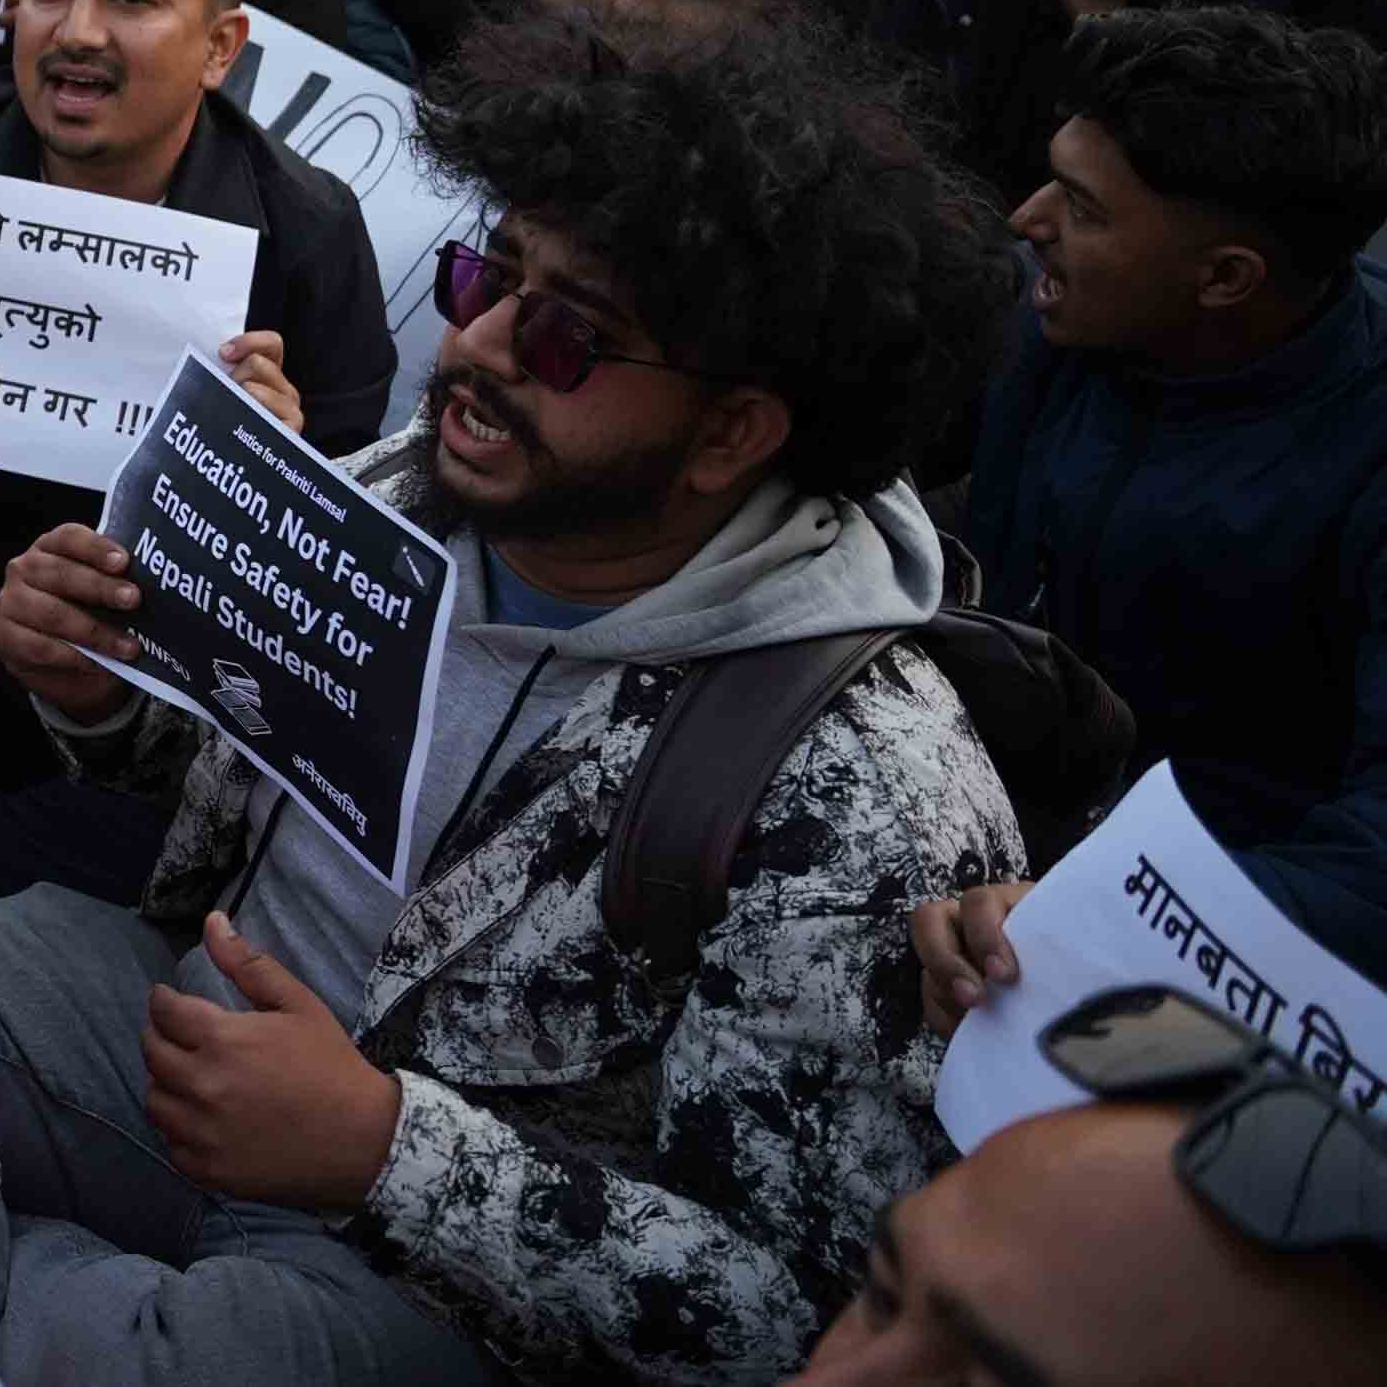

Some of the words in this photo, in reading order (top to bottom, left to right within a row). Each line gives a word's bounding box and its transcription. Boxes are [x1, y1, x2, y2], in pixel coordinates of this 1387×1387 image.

[17, 220, 200, 282] लम्सालको
[43, 387, 98, 429] गर
[163, 411, 273, 535] Education,
[278, 508, 331, 574] Not
[332, 548, 413, 630] Fear!
[232, 423, 264, 458] Justice
[262, 444, 278, 466] for
[275, 456, 312, 496] Prakriti
[308, 481, 348, 523] Lamsal
[152, 473, 230, 561] Ensure
[229, 542, 324, 636] Safety
[325, 612, 375, 669] for
[134, 527, 214, 614] Nepali
[215, 596, 357, 720] Students!
[135, 630, 192, 683] NNFSU
